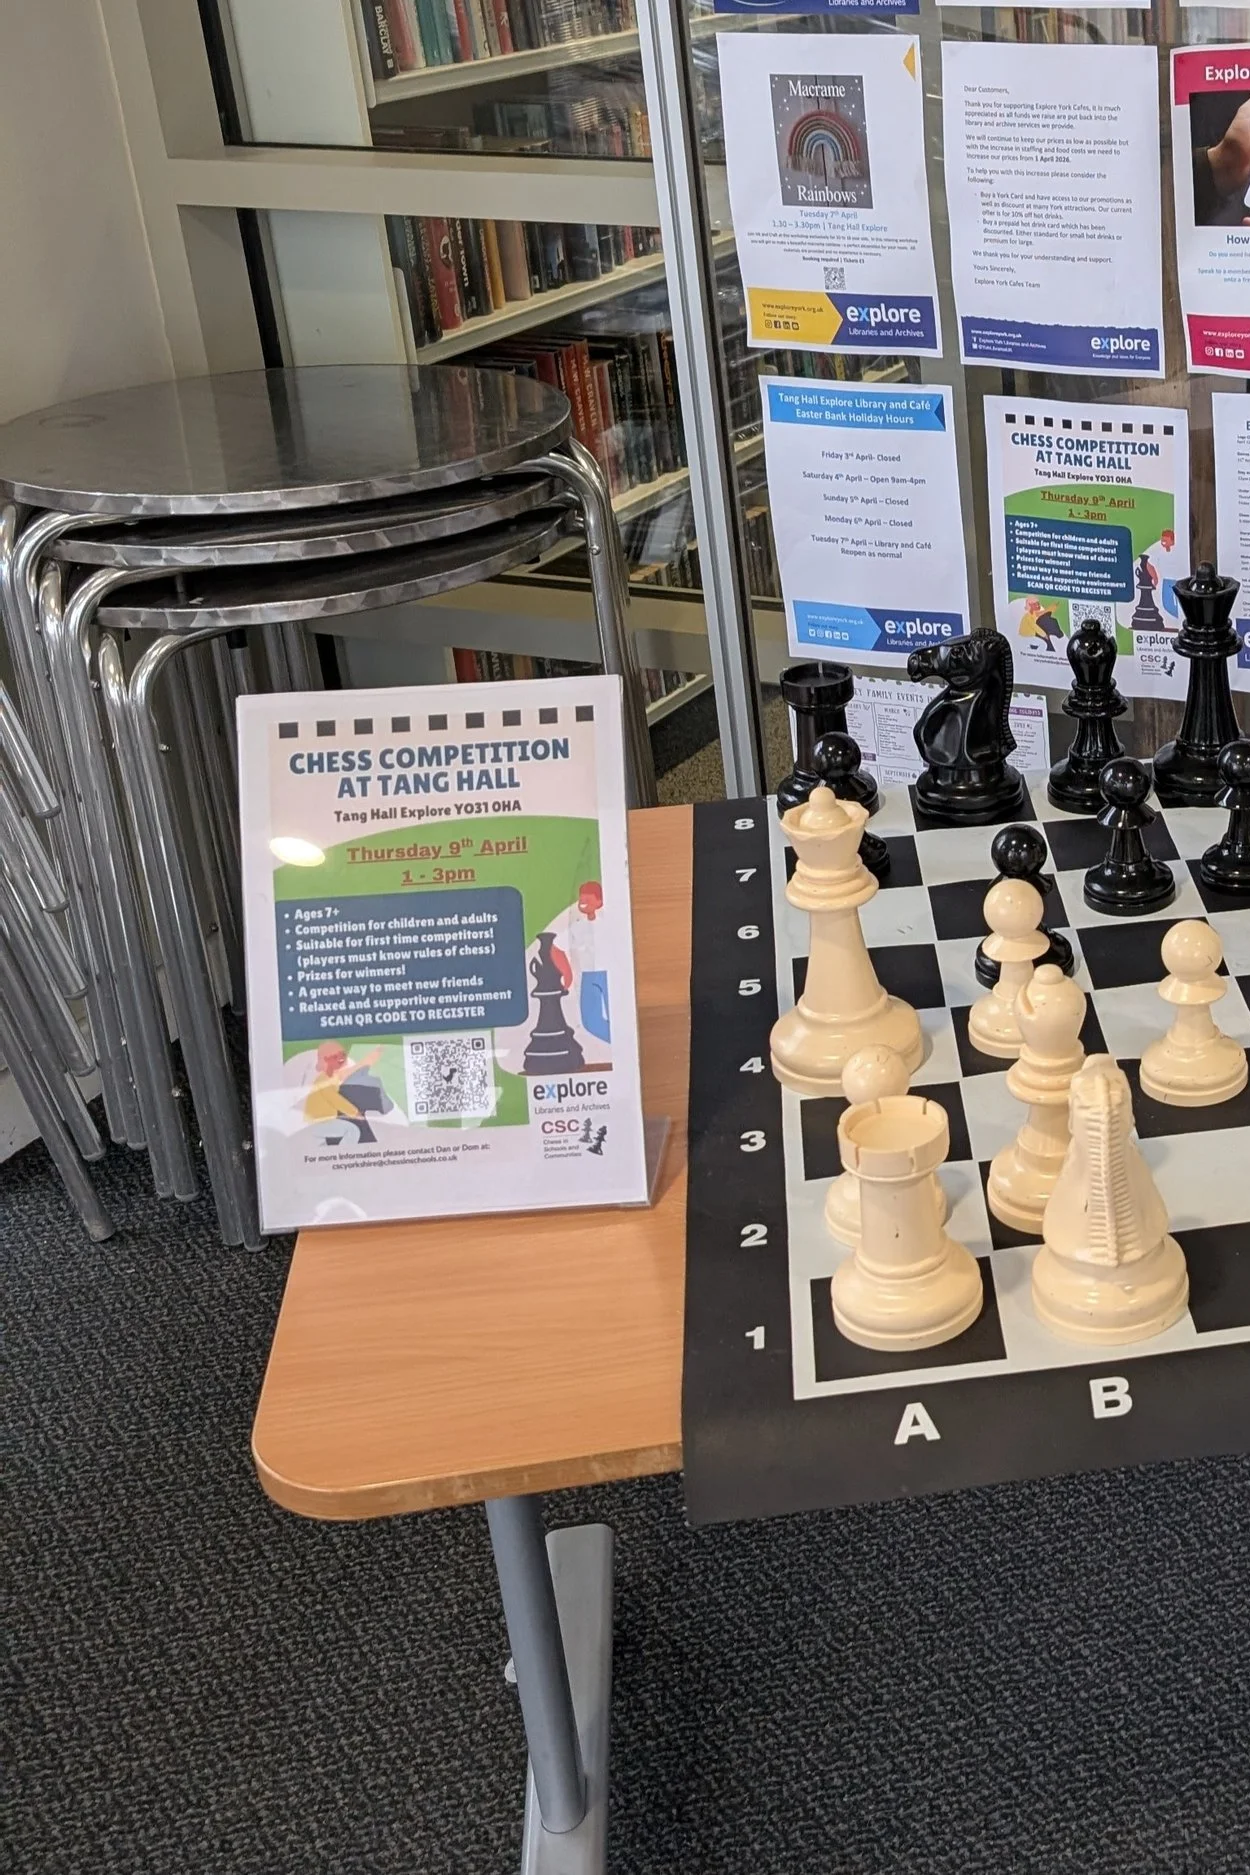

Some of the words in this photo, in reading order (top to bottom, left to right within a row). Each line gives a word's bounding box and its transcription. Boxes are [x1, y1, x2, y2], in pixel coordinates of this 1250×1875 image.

[375, 5, 393, 54] BARCLAY
[788, 80, 845, 98] Macrame
[797, 185, 857, 203] Rainbows
[1226, 234, 1250, 244] How
[846, 304, 921, 325] explore
[848, 327, 878, 335] Libraries
[879, 328, 893, 336] and
[894, 328, 924, 337] Archives
[1090, 336, 1150, 352] explore
[778, 392, 800, 405] Tang
[801, 395, 819, 404] Hall
[820, 396, 853, 407] Explore
[855, 398, 887, 410] Library
[889, 400, 907, 408] and
[909, 400, 930, 409] Café
[796, 408, 823, 418] Easter
[824, 410, 847, 420] Bank
[847, 412, 883, 424] Holiday
[884, 414, 914, 423] Hours
[1011, 432, 1053, 448] CHESS
[1055, 437, 1159, 455] COMPETITION
[1035, 450, 1052, 463] AT
[1055, 451, 1092, 467] TANG
[1096, 455, 1131, 469] HALL
[884, 618, 951, 637] explore
[867, 688, 893, 700] FAMILY
[897, 692, 924, 704] EVENTS
[289, 749, 372, 773] CHESS
[378, 738, 569, 768] COMPETITION
[337, 775, 371, 798] AT
[376, 771, 449, 795] TANG
[456, 767, 520, 790] HALL
[333, 810, 367, 823] Tang
[370, 807, 397, 819] Hall
[400, 805, 451, 819] Explore
[453, 801, 488, 814] YO31
[491, 799, 521, 812] 0HA
[735, 819, 754, 829] 8
[347, 844, 442, 864] Thursday
[480, 836, 529, 854] April
[401, 869, 412, 886] 1
[432, 866, 476, 885] 3pm
[736, 869, 756, 882] 7
[294, 908, 323, 921] Ages
[324, 906, 339, 917] 7+
[738, 926, 759, 939] 6
[739, 979, 761, 995] 5
[320, 1014, 353, 1027] SCAN
[354, 1013, 373, 1026] QR
[374, 1010, 407, 1023] CODE
[408, 1009, 425, 1020] TO
[427, 1006, 485, 1019] REGISTER
[740, 1057, 765, 1073] 4
[532, 1078, 607, 1102] explore
[541, 1119, 579, 1133] CSC
[740, 1131, 766, 1152] 3
[741, 1224, 767, 1247] 2
[746, 1326, 764, 1349] 1
[1089, 1377, 1132, 1419] B
[894, 1403, 940, 1445] A
